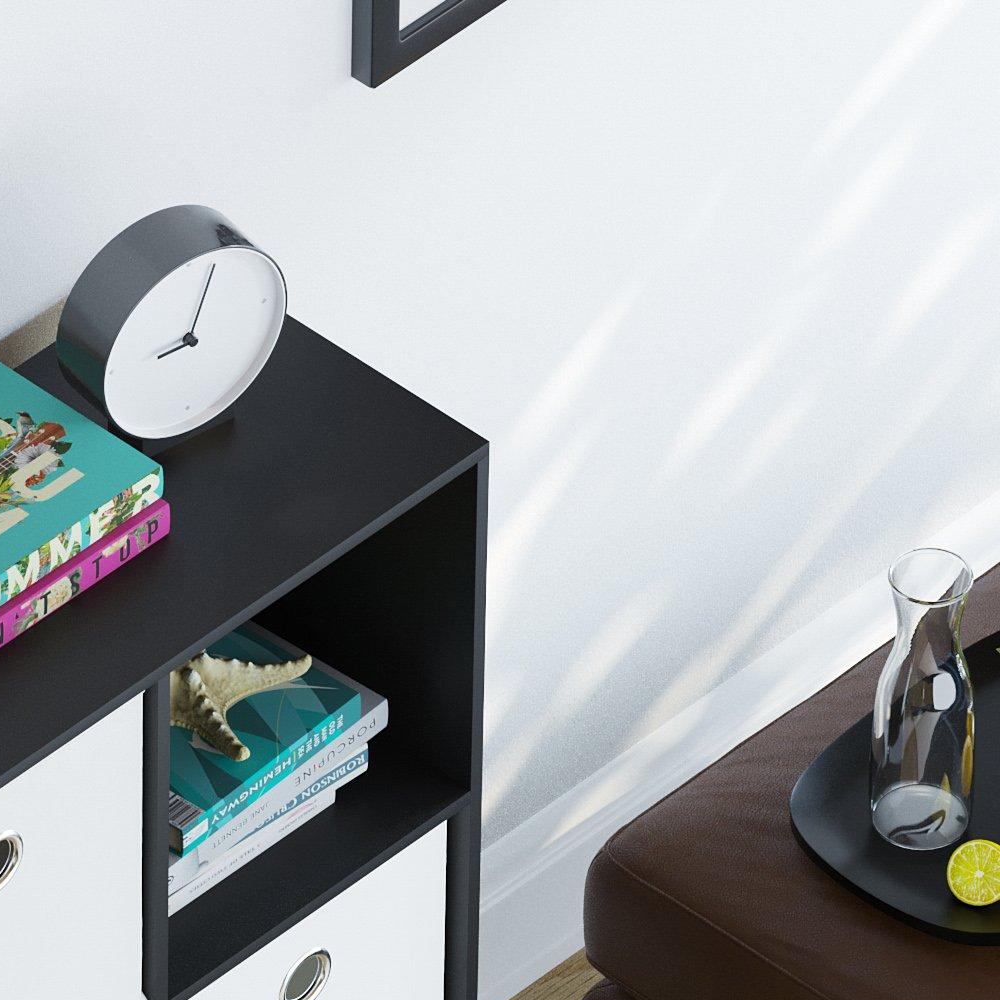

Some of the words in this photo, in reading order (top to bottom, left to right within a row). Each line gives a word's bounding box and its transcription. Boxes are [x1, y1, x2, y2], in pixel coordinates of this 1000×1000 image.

[294, 717, 376, 786] PORCUPINE
[301, 754, 366, 801] ROBINSON
[211, 757, 292, 825] HEMINGWAY
